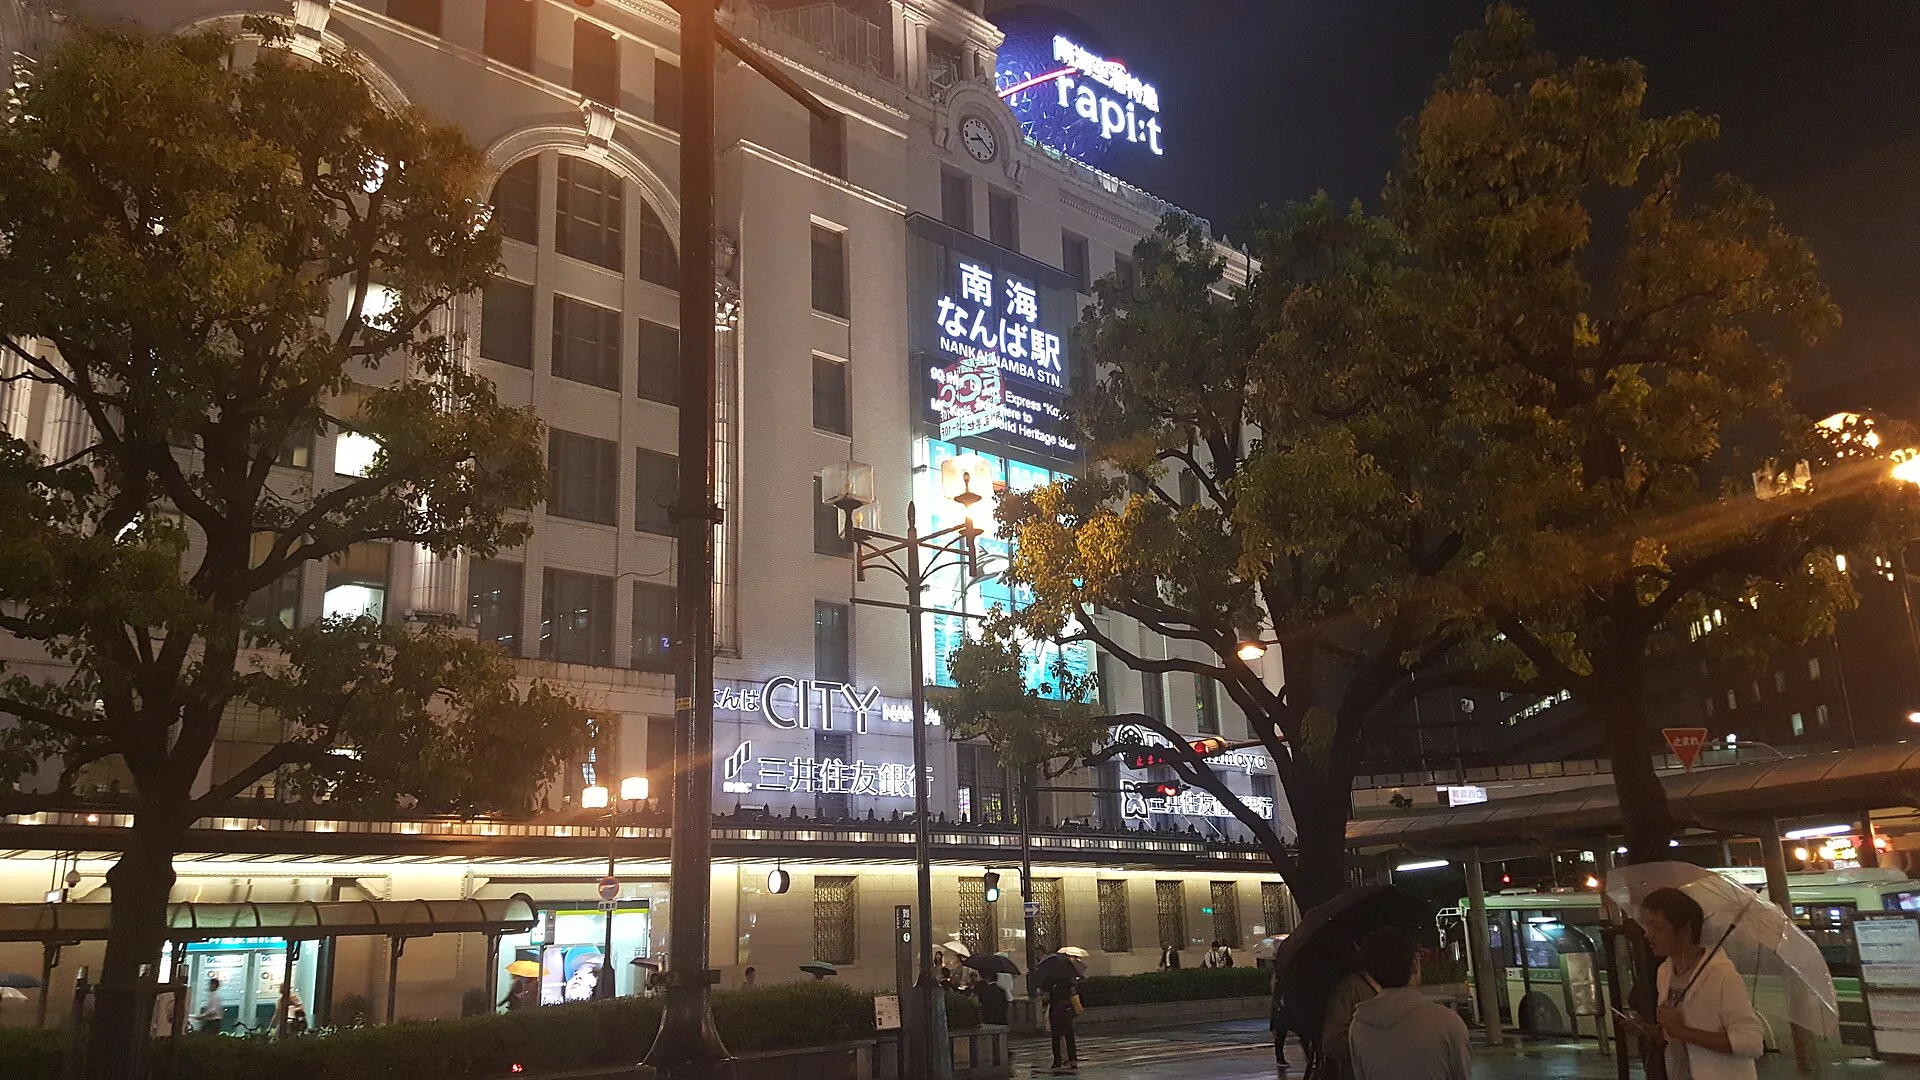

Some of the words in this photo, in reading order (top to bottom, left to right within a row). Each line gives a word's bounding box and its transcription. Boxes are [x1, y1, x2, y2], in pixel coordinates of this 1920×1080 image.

[959, 262, 1038, 323] 南海
[936, 295, 1062, 372] なんば駅
[1037, 369, 1063, 388] STN.
[1005, 390, 1041, 412] Express
[1022, 411, 1033, 424] to
[1018, 423, 1057, 446] Heritage
[762, 675, 880, 734] CITY
[757, 756, 934, 798] 三井住友銀行
